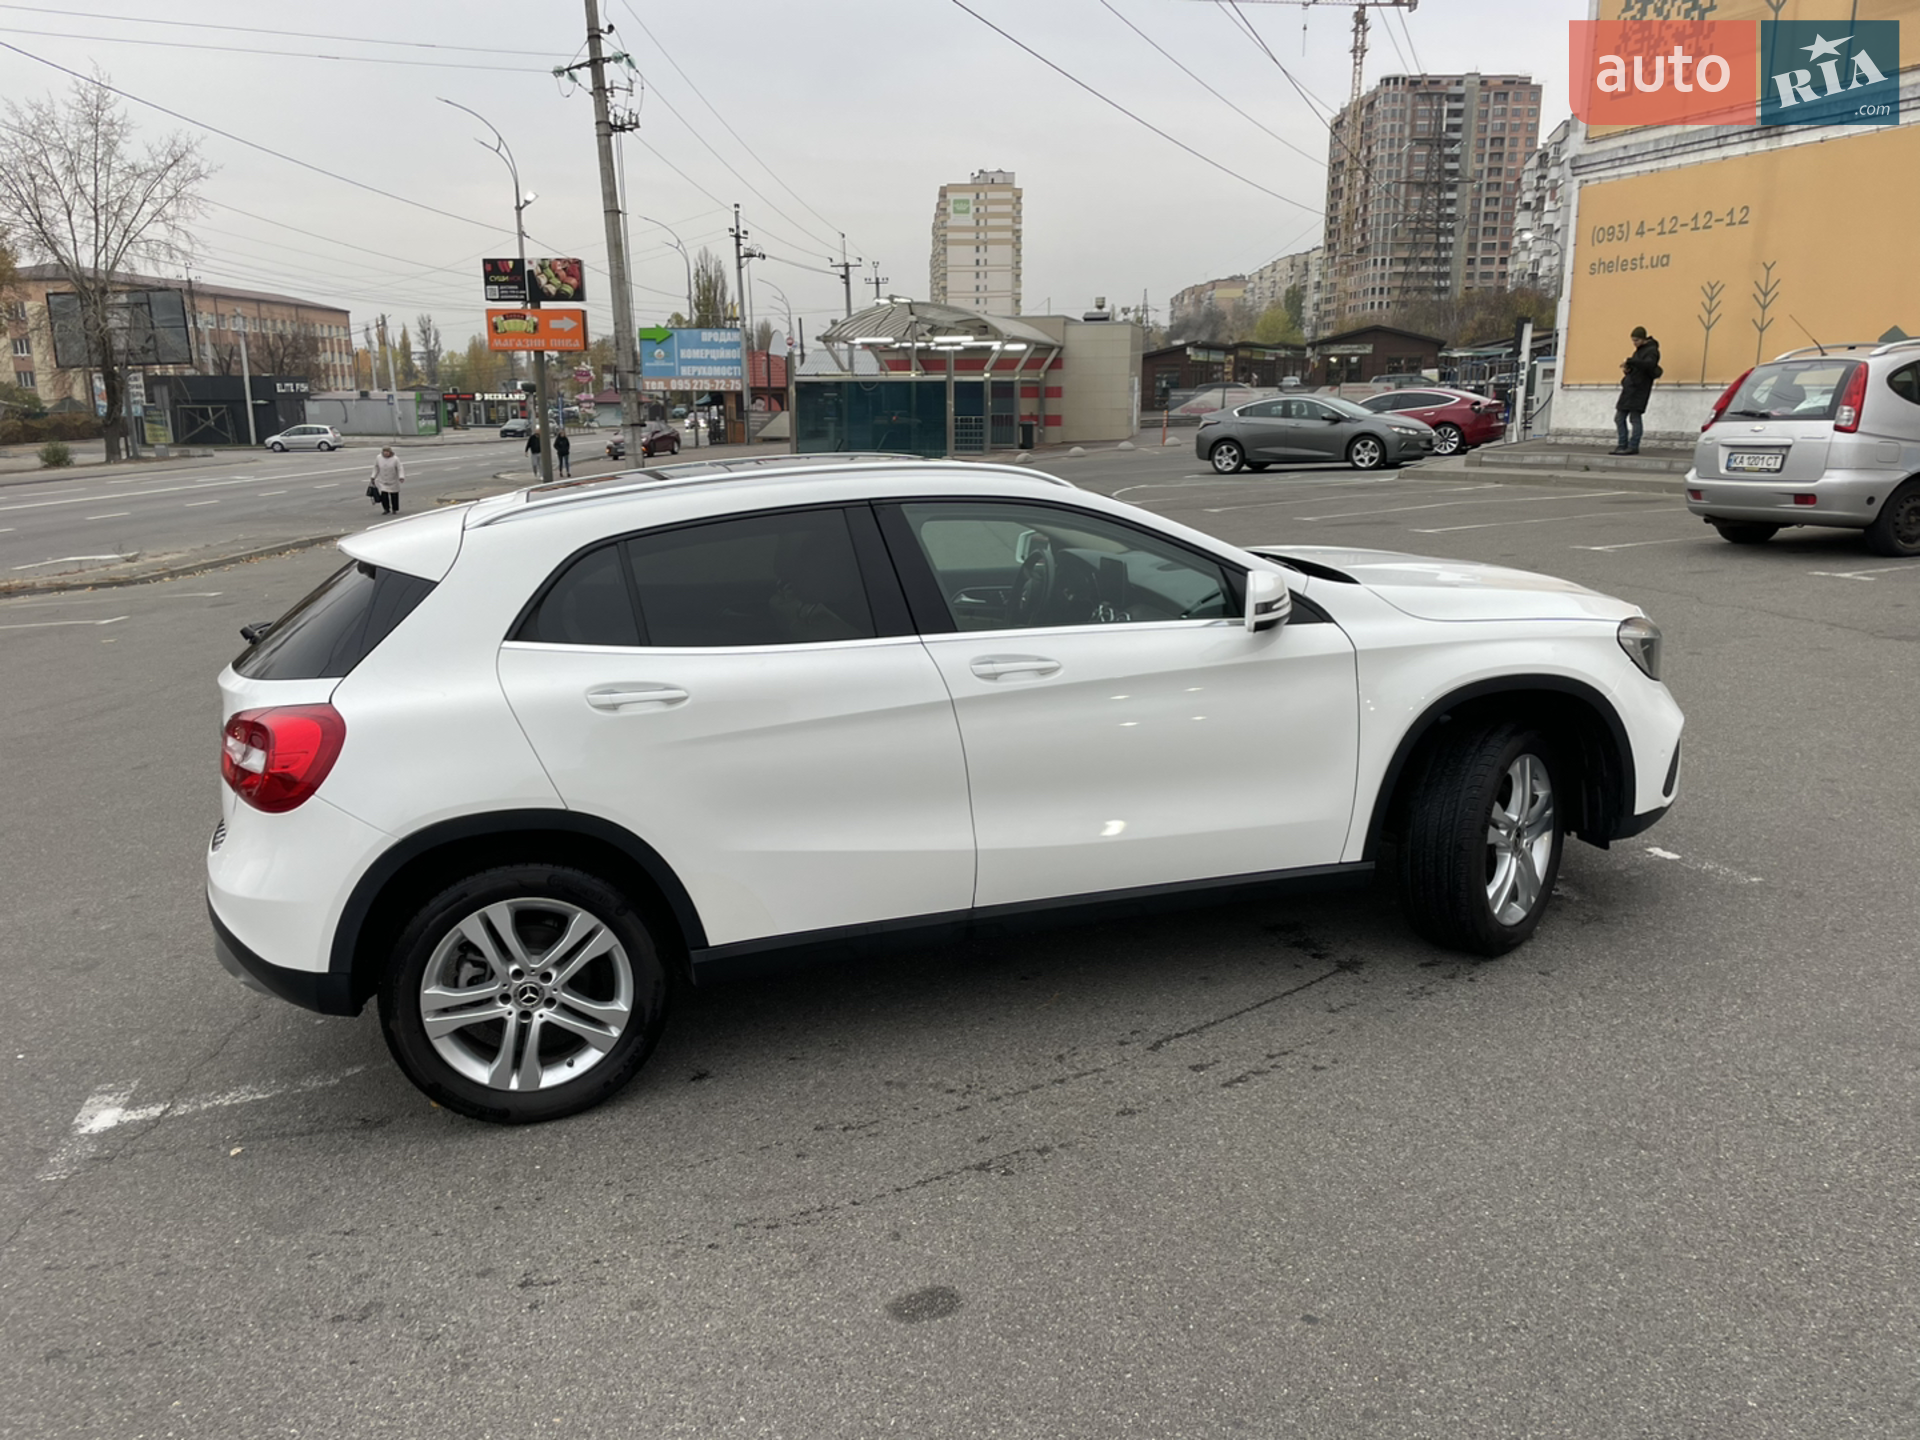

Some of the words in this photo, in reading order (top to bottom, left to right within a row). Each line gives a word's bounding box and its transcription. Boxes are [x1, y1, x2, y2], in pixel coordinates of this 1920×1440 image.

[1591, 221, 1630, 247] (093)
[1635, 205, 1750, 239] 4-12-12-12
[1589, 250, 1671, 276] shelest.ua
[491, 338, 546, 348] МАГАЗИН
[549, 338, 580, 348] ПИВА
[701, 331, 741, 343] ПРОДАЖ
[679, 347, 742, 360] КОМЕРЦІЙНОЇ
[680, 365, 742, 376] НЕРУХОМОСТІ
[644, 380, 668, 390] тел.
[670, 379, 691, 390] 095
[691, 379, 742, 390] 275-72-75
